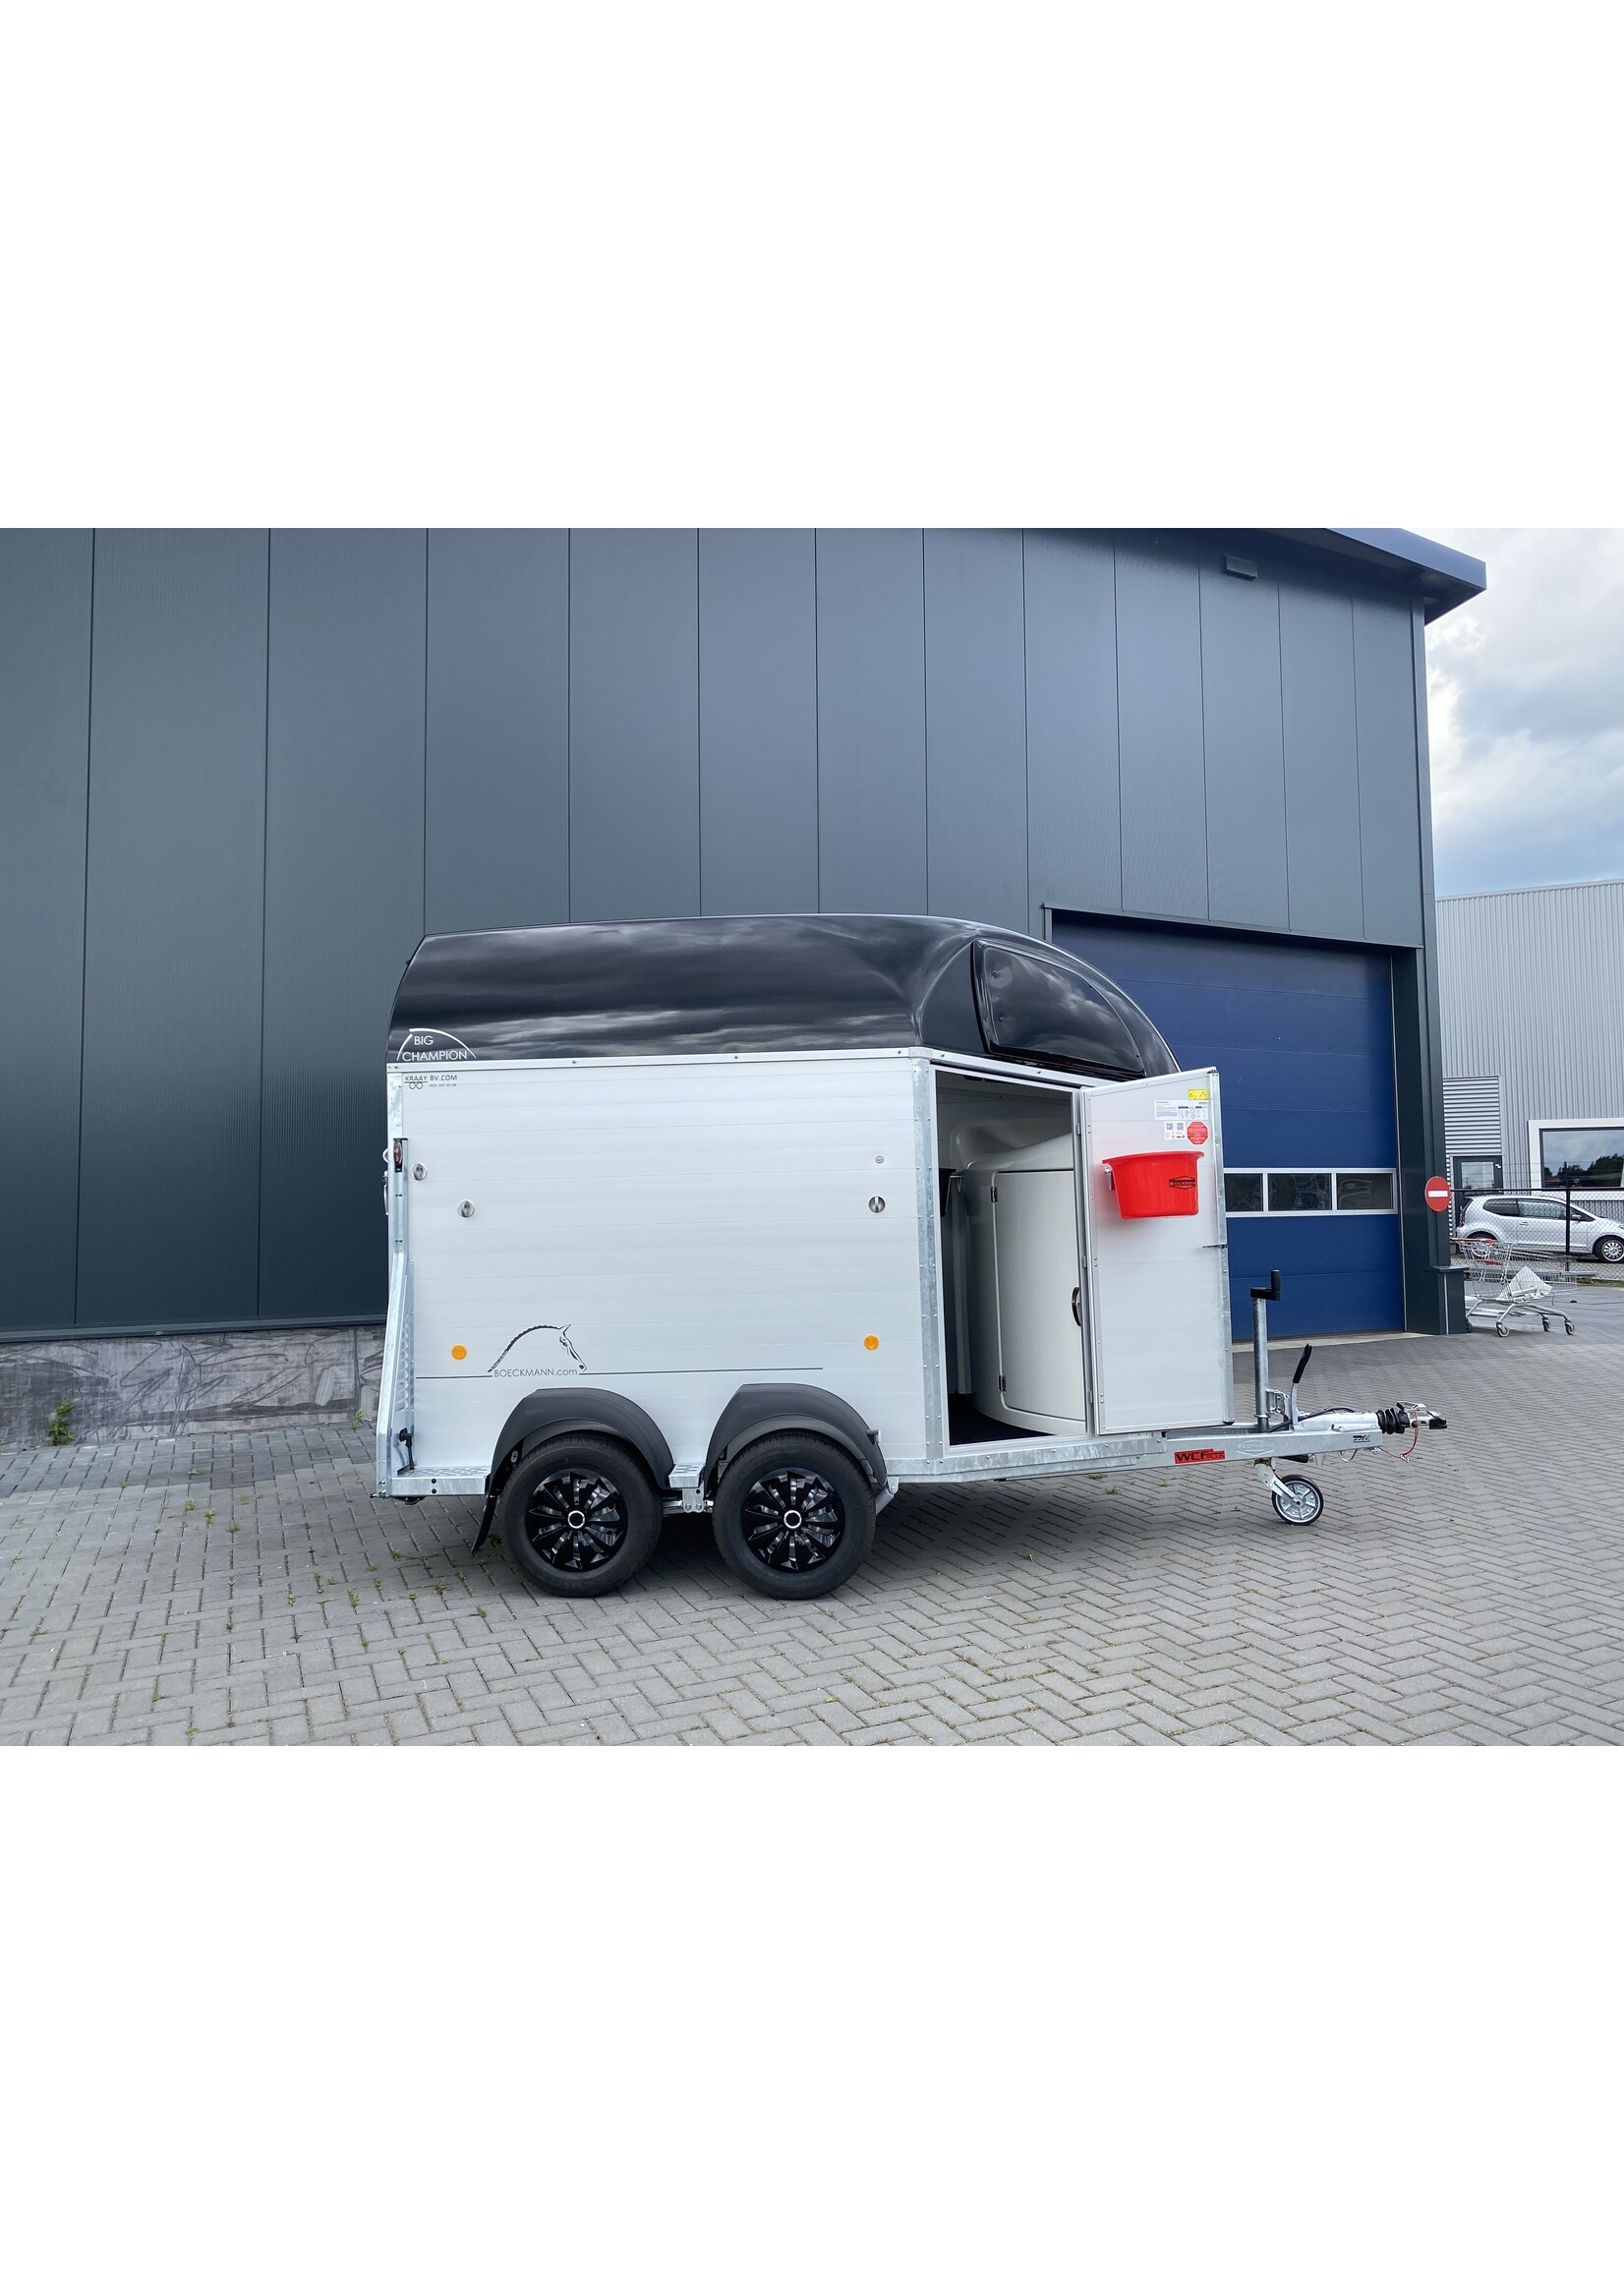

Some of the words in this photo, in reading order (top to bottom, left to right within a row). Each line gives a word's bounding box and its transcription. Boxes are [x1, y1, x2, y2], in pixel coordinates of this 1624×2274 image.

[414, 1035, 434, 1046] BIG
[402, 1050, 467, 1062] CHAMPION
[493, 1369, 577, 1377] BOECKMANN.com
